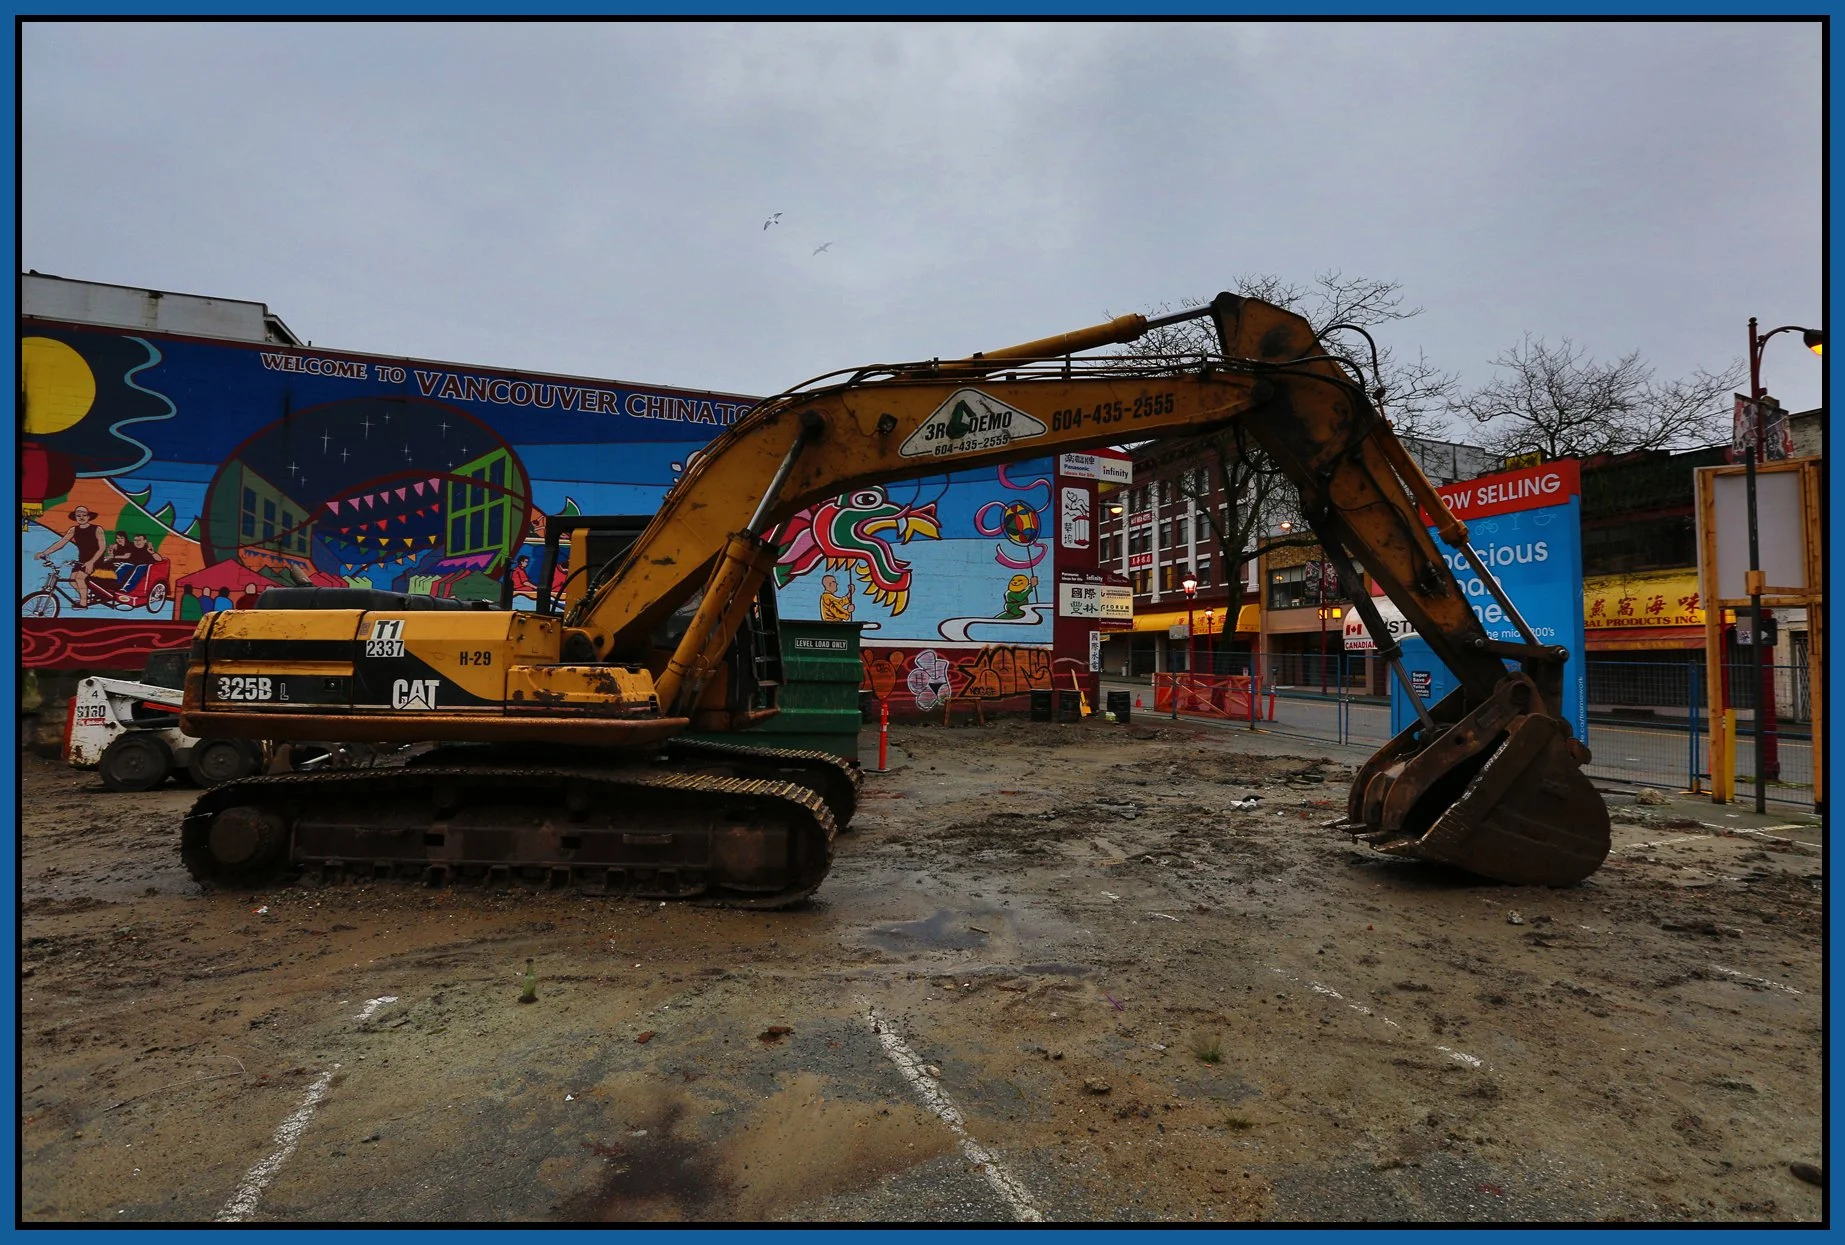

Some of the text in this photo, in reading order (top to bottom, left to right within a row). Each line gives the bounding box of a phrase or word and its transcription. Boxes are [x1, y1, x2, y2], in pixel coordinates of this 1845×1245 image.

[260, 352, 754, 427] WELCOME TO VANCOUVER CHINATO
[1052, 392, 1174, 432] 604-435-2555
[925, 411, 1012, 441] 3R DEMO
[934, 434, 1009, 457] 604-435-2555
[1103, 466, 1129, 479] infinity
[1439, 473, 1561, 511] OW SELLING
[1086, 573, 1103, 582] infinity
[1071, 587, 1097, 600] 國際
[377, 620, 400, 639] T1
[1584, 615, 1701, 627] BAL PRODUCTS INC.
[366, 640, 404, 657] 2337
[796, 639, 847, 649] LEVEL LOAD ONLY
[460, 651, 491, 666] H-29
[91, 690, 99, 699] 4
[217, 677, 290, 700] 325B L
[392, 678, 441, 710] CAT
